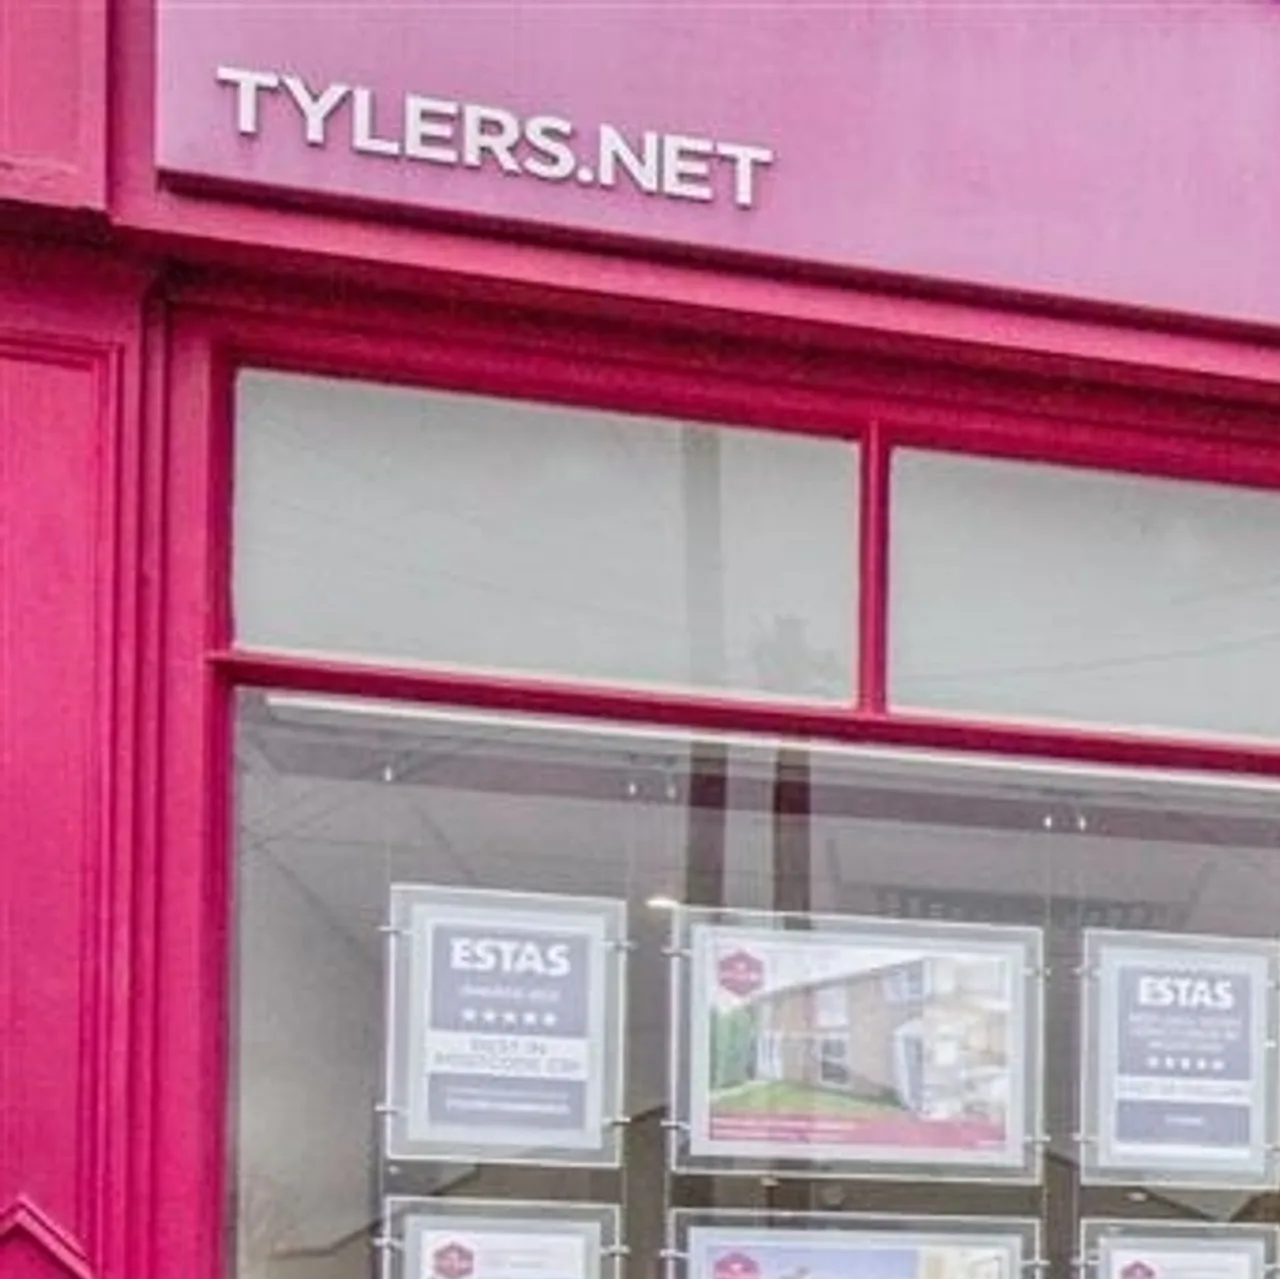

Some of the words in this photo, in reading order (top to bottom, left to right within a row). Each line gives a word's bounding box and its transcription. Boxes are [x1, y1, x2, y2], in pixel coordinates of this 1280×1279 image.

[217, 66, 774, 209] TYLERS.NET
[450, 936, 572, 977] ESTAS
[1137, 975, 1235, 1010] ESTAS
